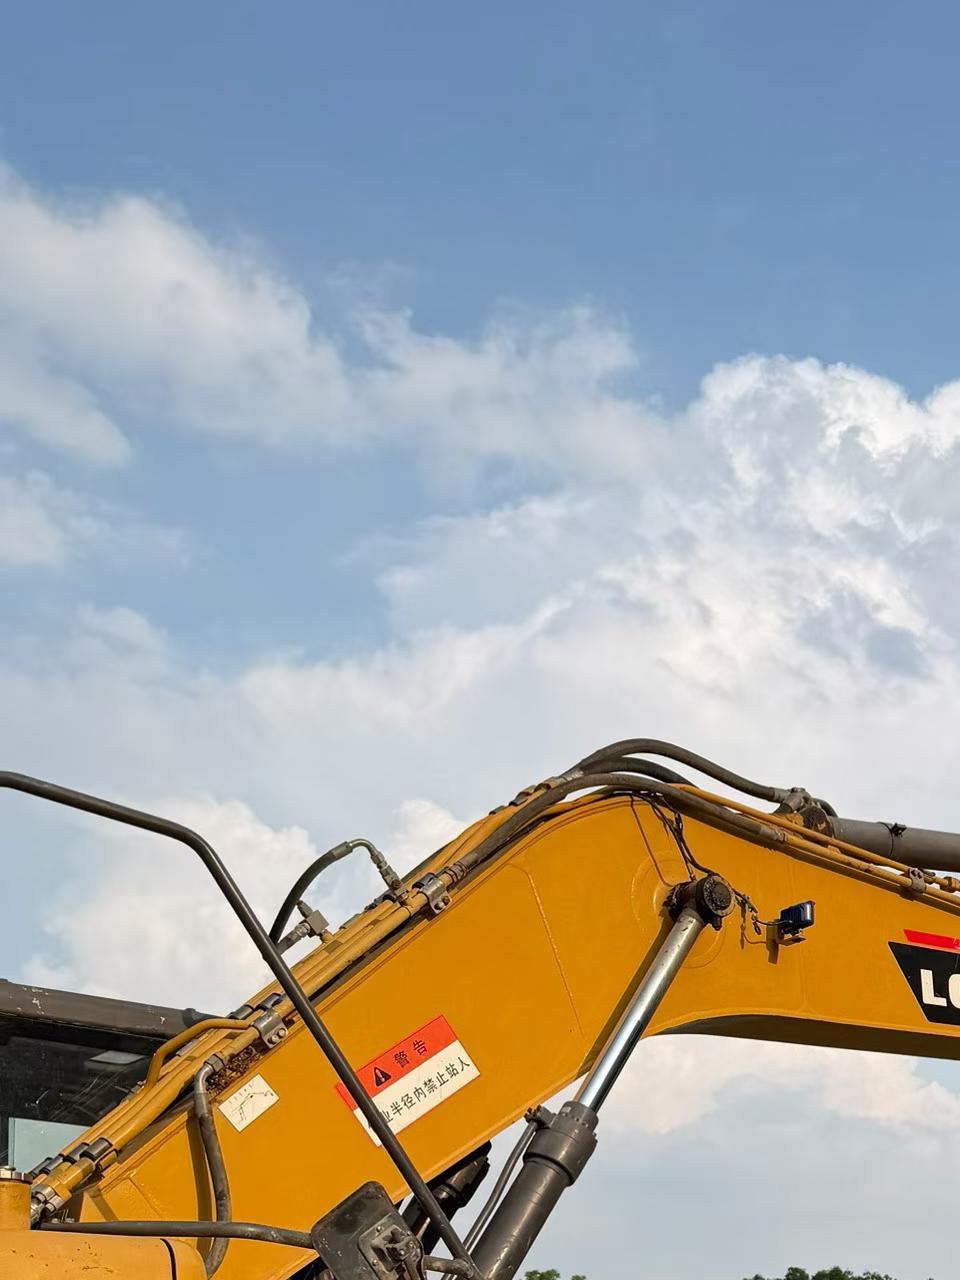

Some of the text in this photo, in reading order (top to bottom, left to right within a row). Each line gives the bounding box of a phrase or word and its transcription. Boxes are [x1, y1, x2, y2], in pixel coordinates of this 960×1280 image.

[392, 1039, 428, 1068] 警告
[367, 1055, 471, 1128] 业半径内禁止站人
